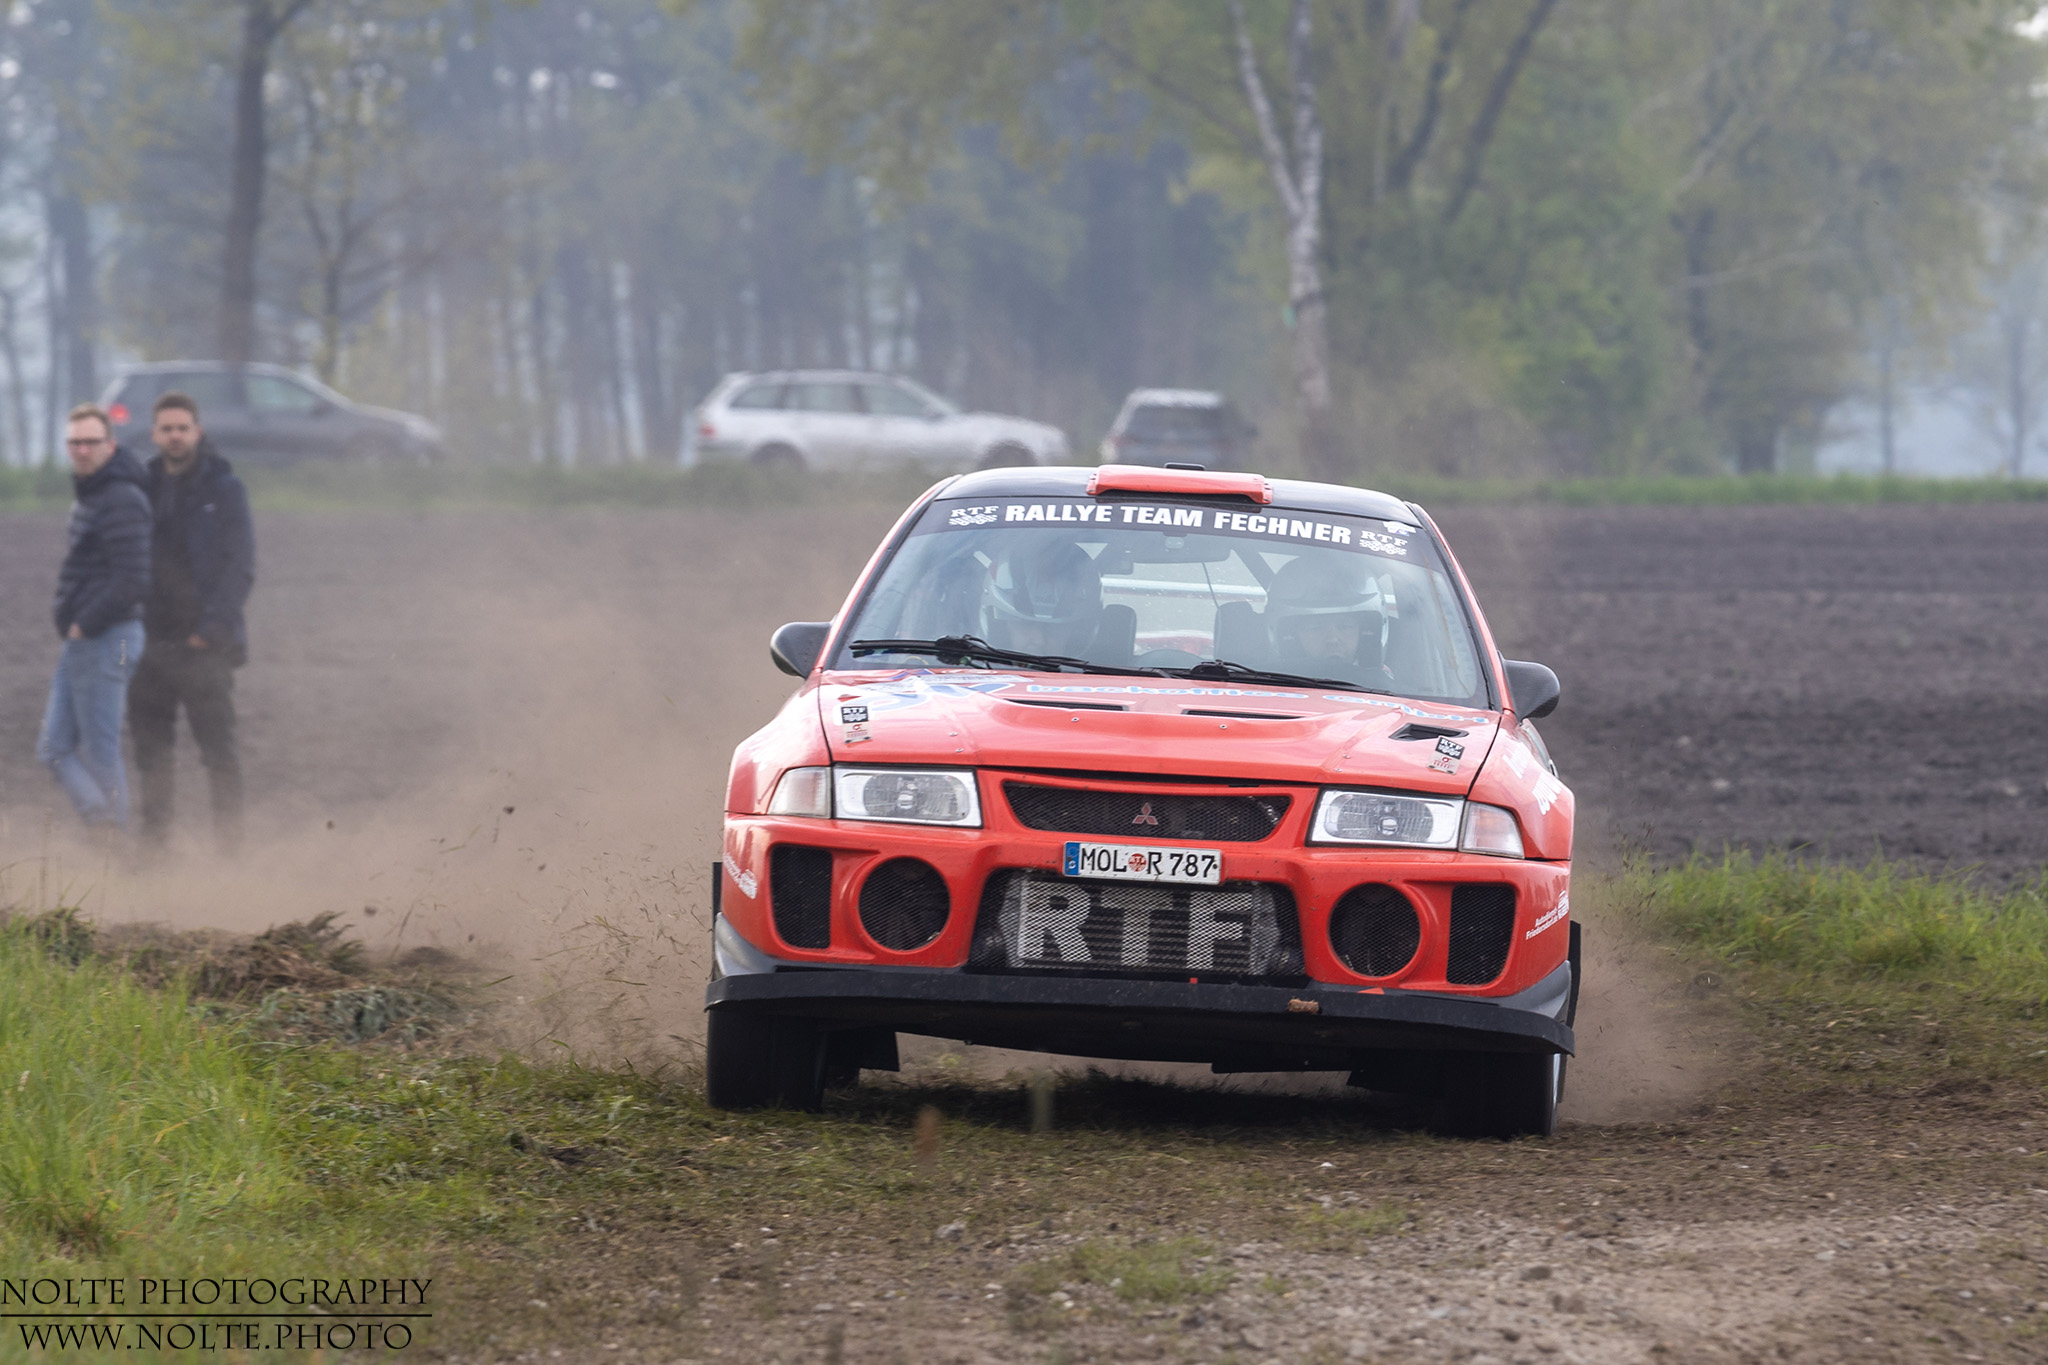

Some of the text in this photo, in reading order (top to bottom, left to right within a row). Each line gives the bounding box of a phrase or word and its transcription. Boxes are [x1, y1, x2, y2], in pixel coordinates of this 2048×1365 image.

[951, 505, 998, 518] RTF
[1005, 504, 1351, 544] RALLYE TEAM FECHNER
[1361, 530, 1408, 547] RTF
[1080, 847, 1214, 878] MOL R 787
[1019, 881, 1252, 968] RTF
